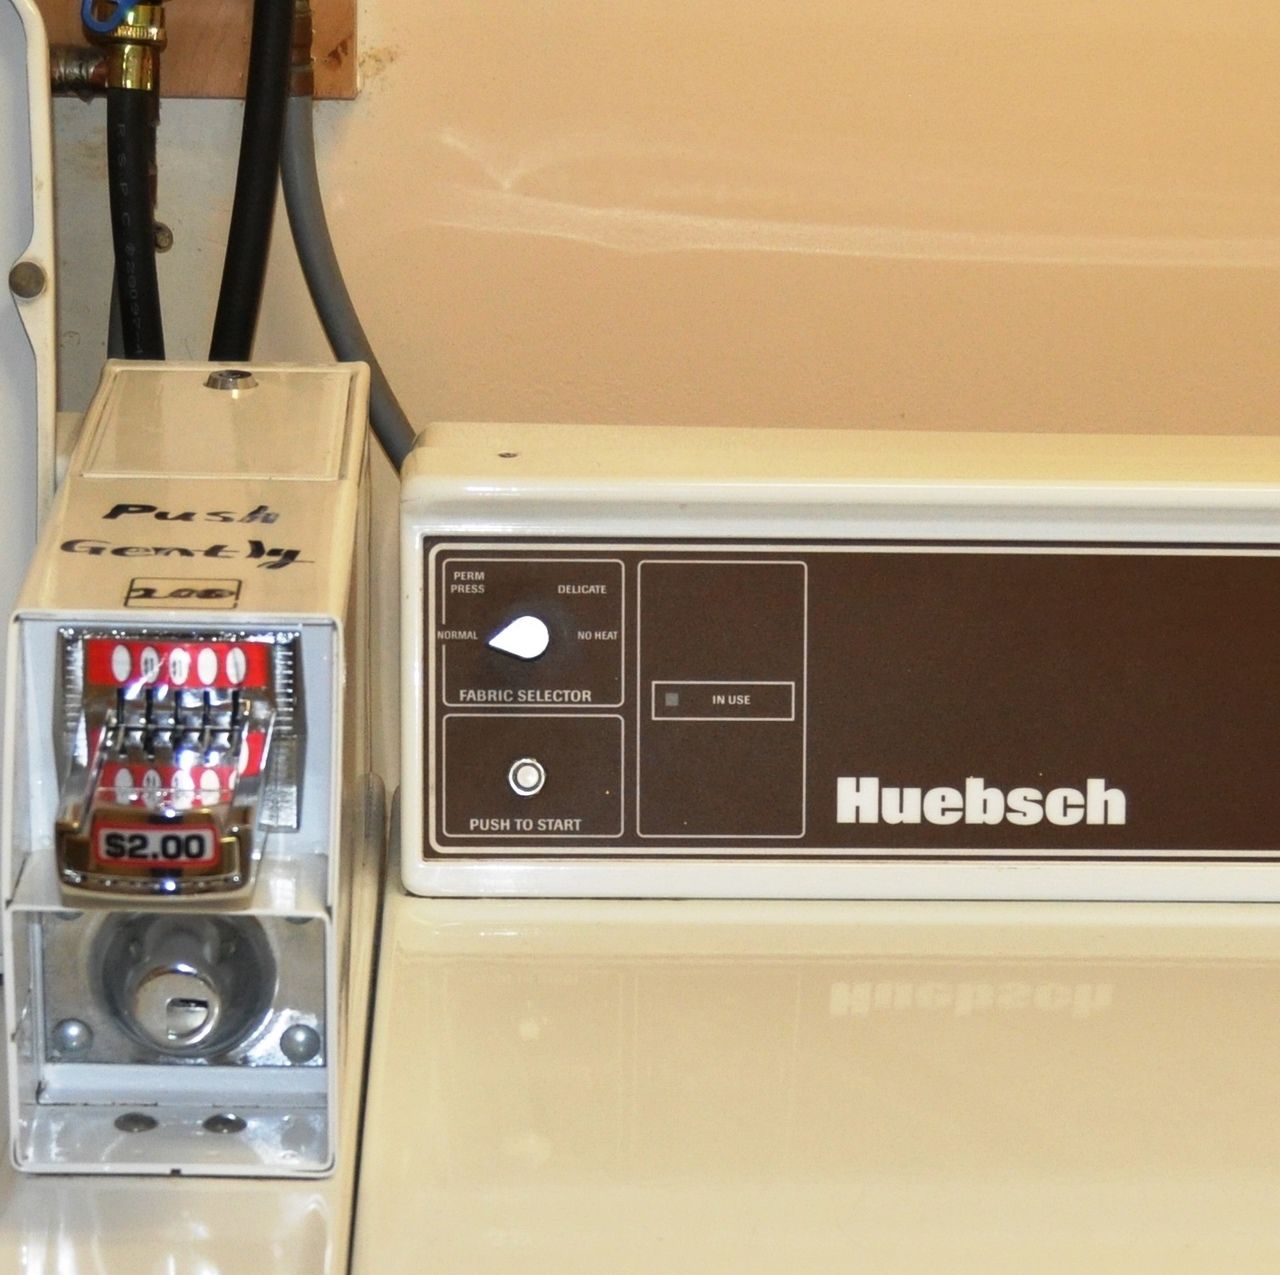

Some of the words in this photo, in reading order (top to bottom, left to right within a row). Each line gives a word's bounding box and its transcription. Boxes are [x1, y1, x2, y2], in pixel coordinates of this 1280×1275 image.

[102, 503, 279, 524] Push
[60, 539, 315, 569] Gently
[453, 571, 485, 582] PERM
[450, 584, 485, 594] PRESS
[557, 584, 607, 595] DELICATE
[437, 630, 478, 640] NORMAL
[577, 630, 592, 640] NO
[594, 631, 618, 641] HEAT
[459, 690, 513, 702] FABRIC
[517, 690, 592, 702] SELECTOR
[712, 695, 724, 705] IN
[727, 695, 751, 705] USE
[836, 776, 1127, 826] Huebsch
[469, 818, 510, 831] PUSH
[514, 818, 533, 831] TO
[537, 818, 582, 831] START
[104, 833, 206, 860] $2.00
